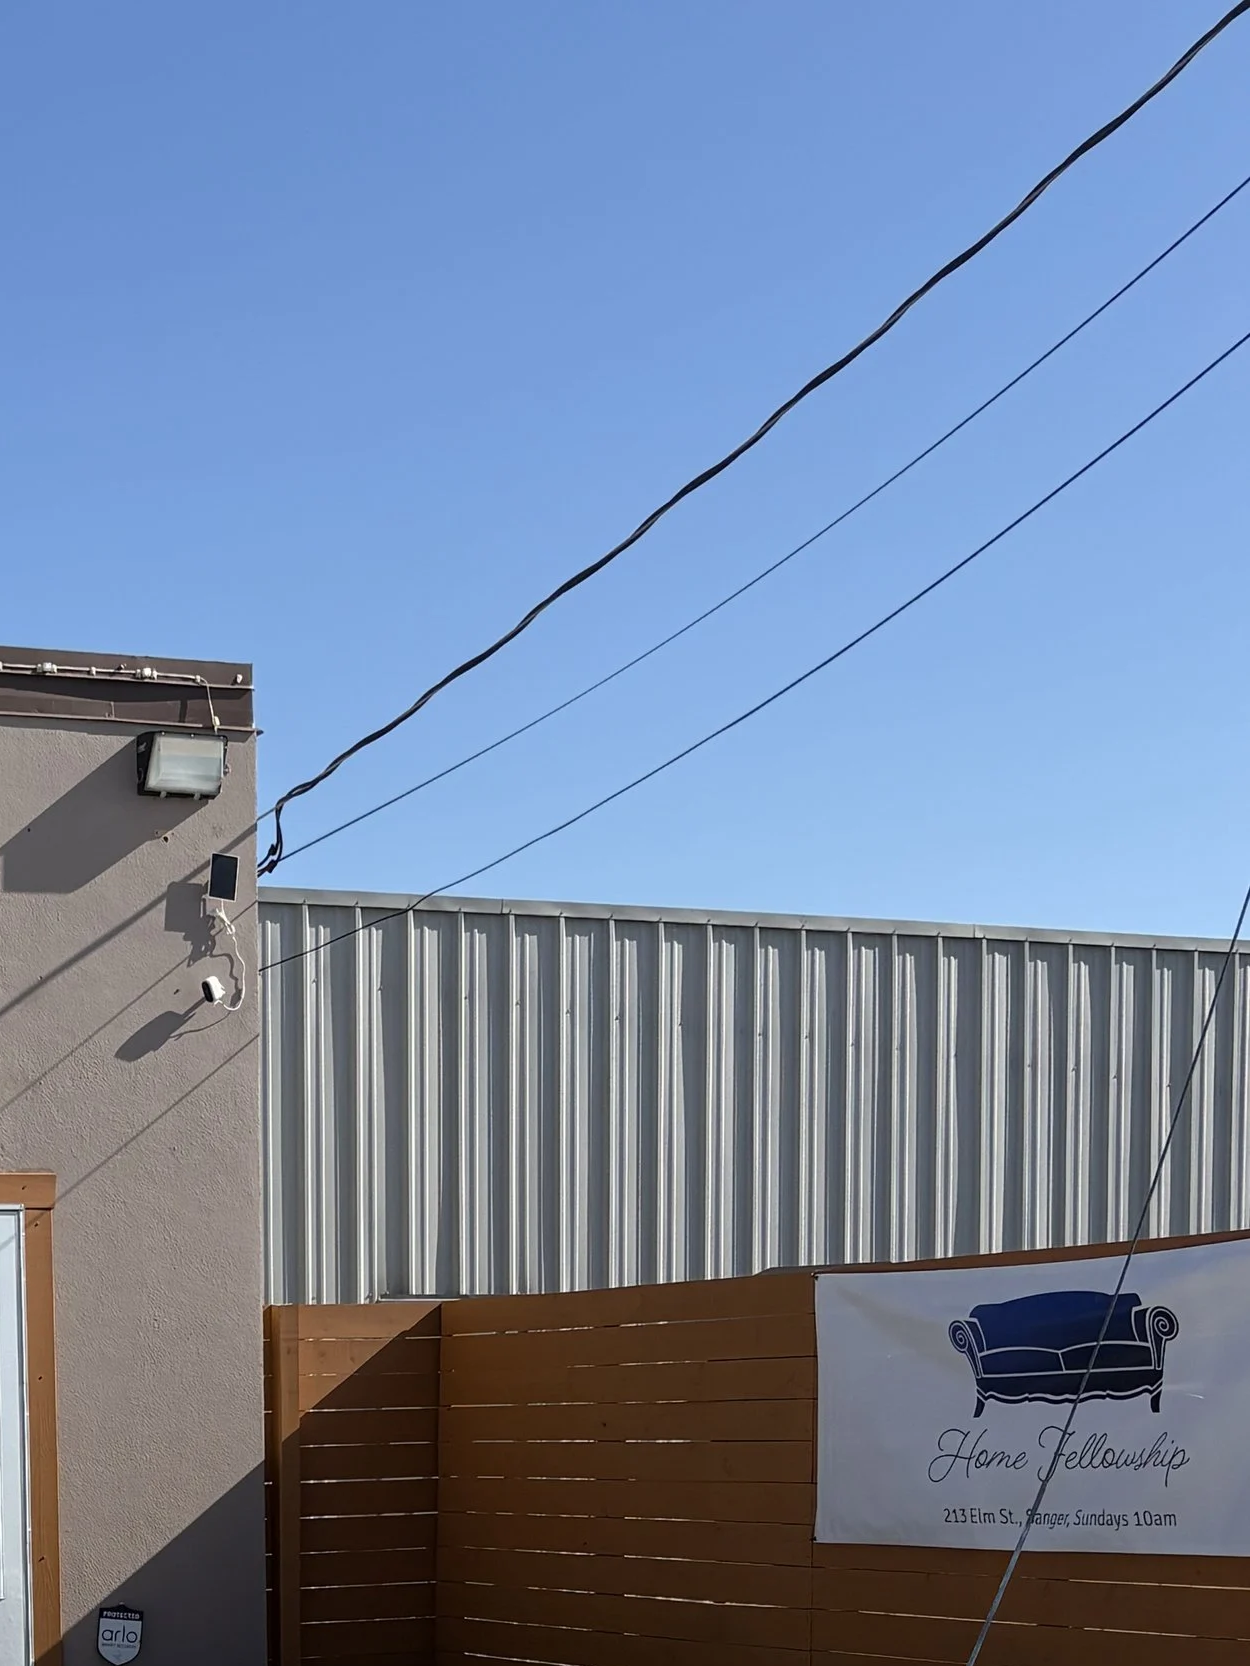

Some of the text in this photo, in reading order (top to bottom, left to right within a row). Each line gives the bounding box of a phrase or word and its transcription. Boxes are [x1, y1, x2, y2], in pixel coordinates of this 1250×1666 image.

[928, 1425, 1191, 1488] Home Fellowship
[943, 1508, 967, 1523] 213
[970, 1507, 996, 1524] Elm
[1000, 1508, 1022, 1527] St.,
[1073, 1509, 1129, 1531] Sundays
[1133, 1510, 1178, 1527] 10am
[103, 1611, 140, 1619] PROTECTED
[102, 1625, 138, 1643] arlo
